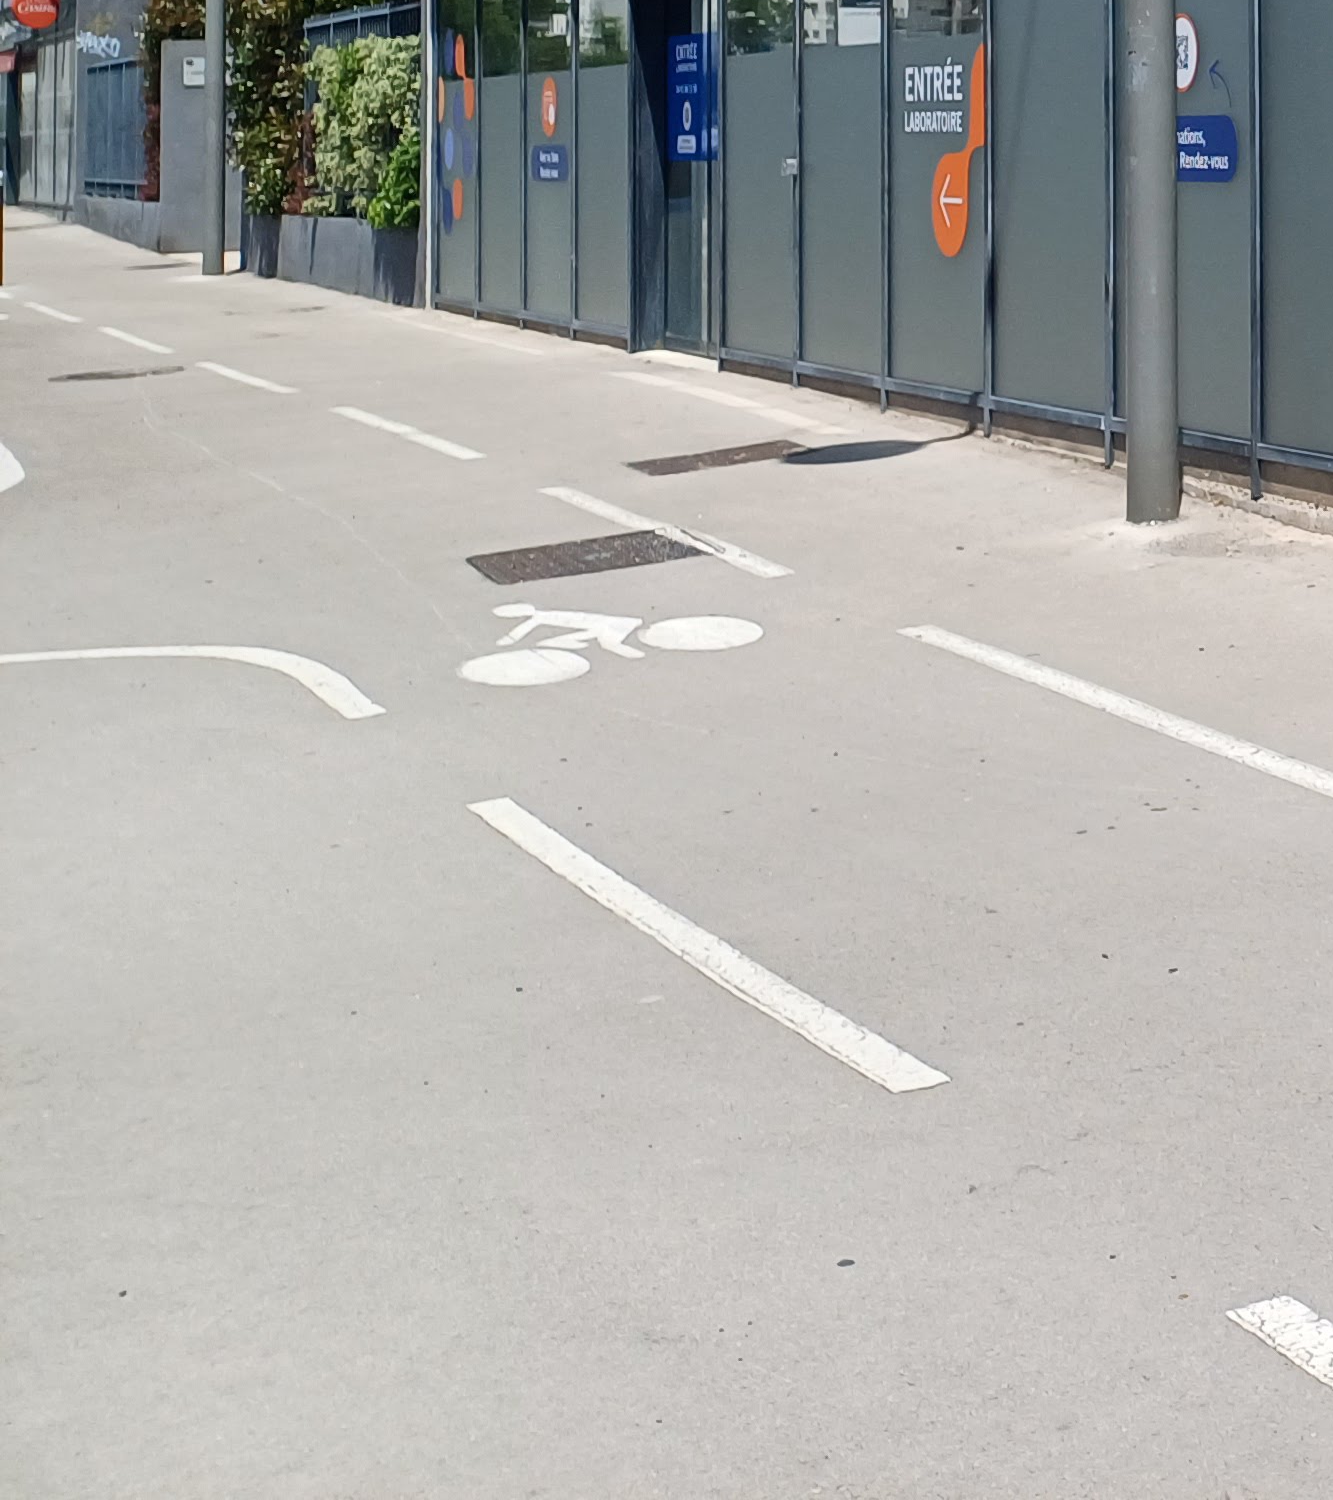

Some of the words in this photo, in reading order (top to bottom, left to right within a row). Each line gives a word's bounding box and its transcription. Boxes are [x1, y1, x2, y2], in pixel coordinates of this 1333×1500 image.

[904, 56, 964, 102] ENTRÉE
[904, 110, 963, 133] LABORATOIRE
[1180, 151, 1229, 170] Rendez-vous
